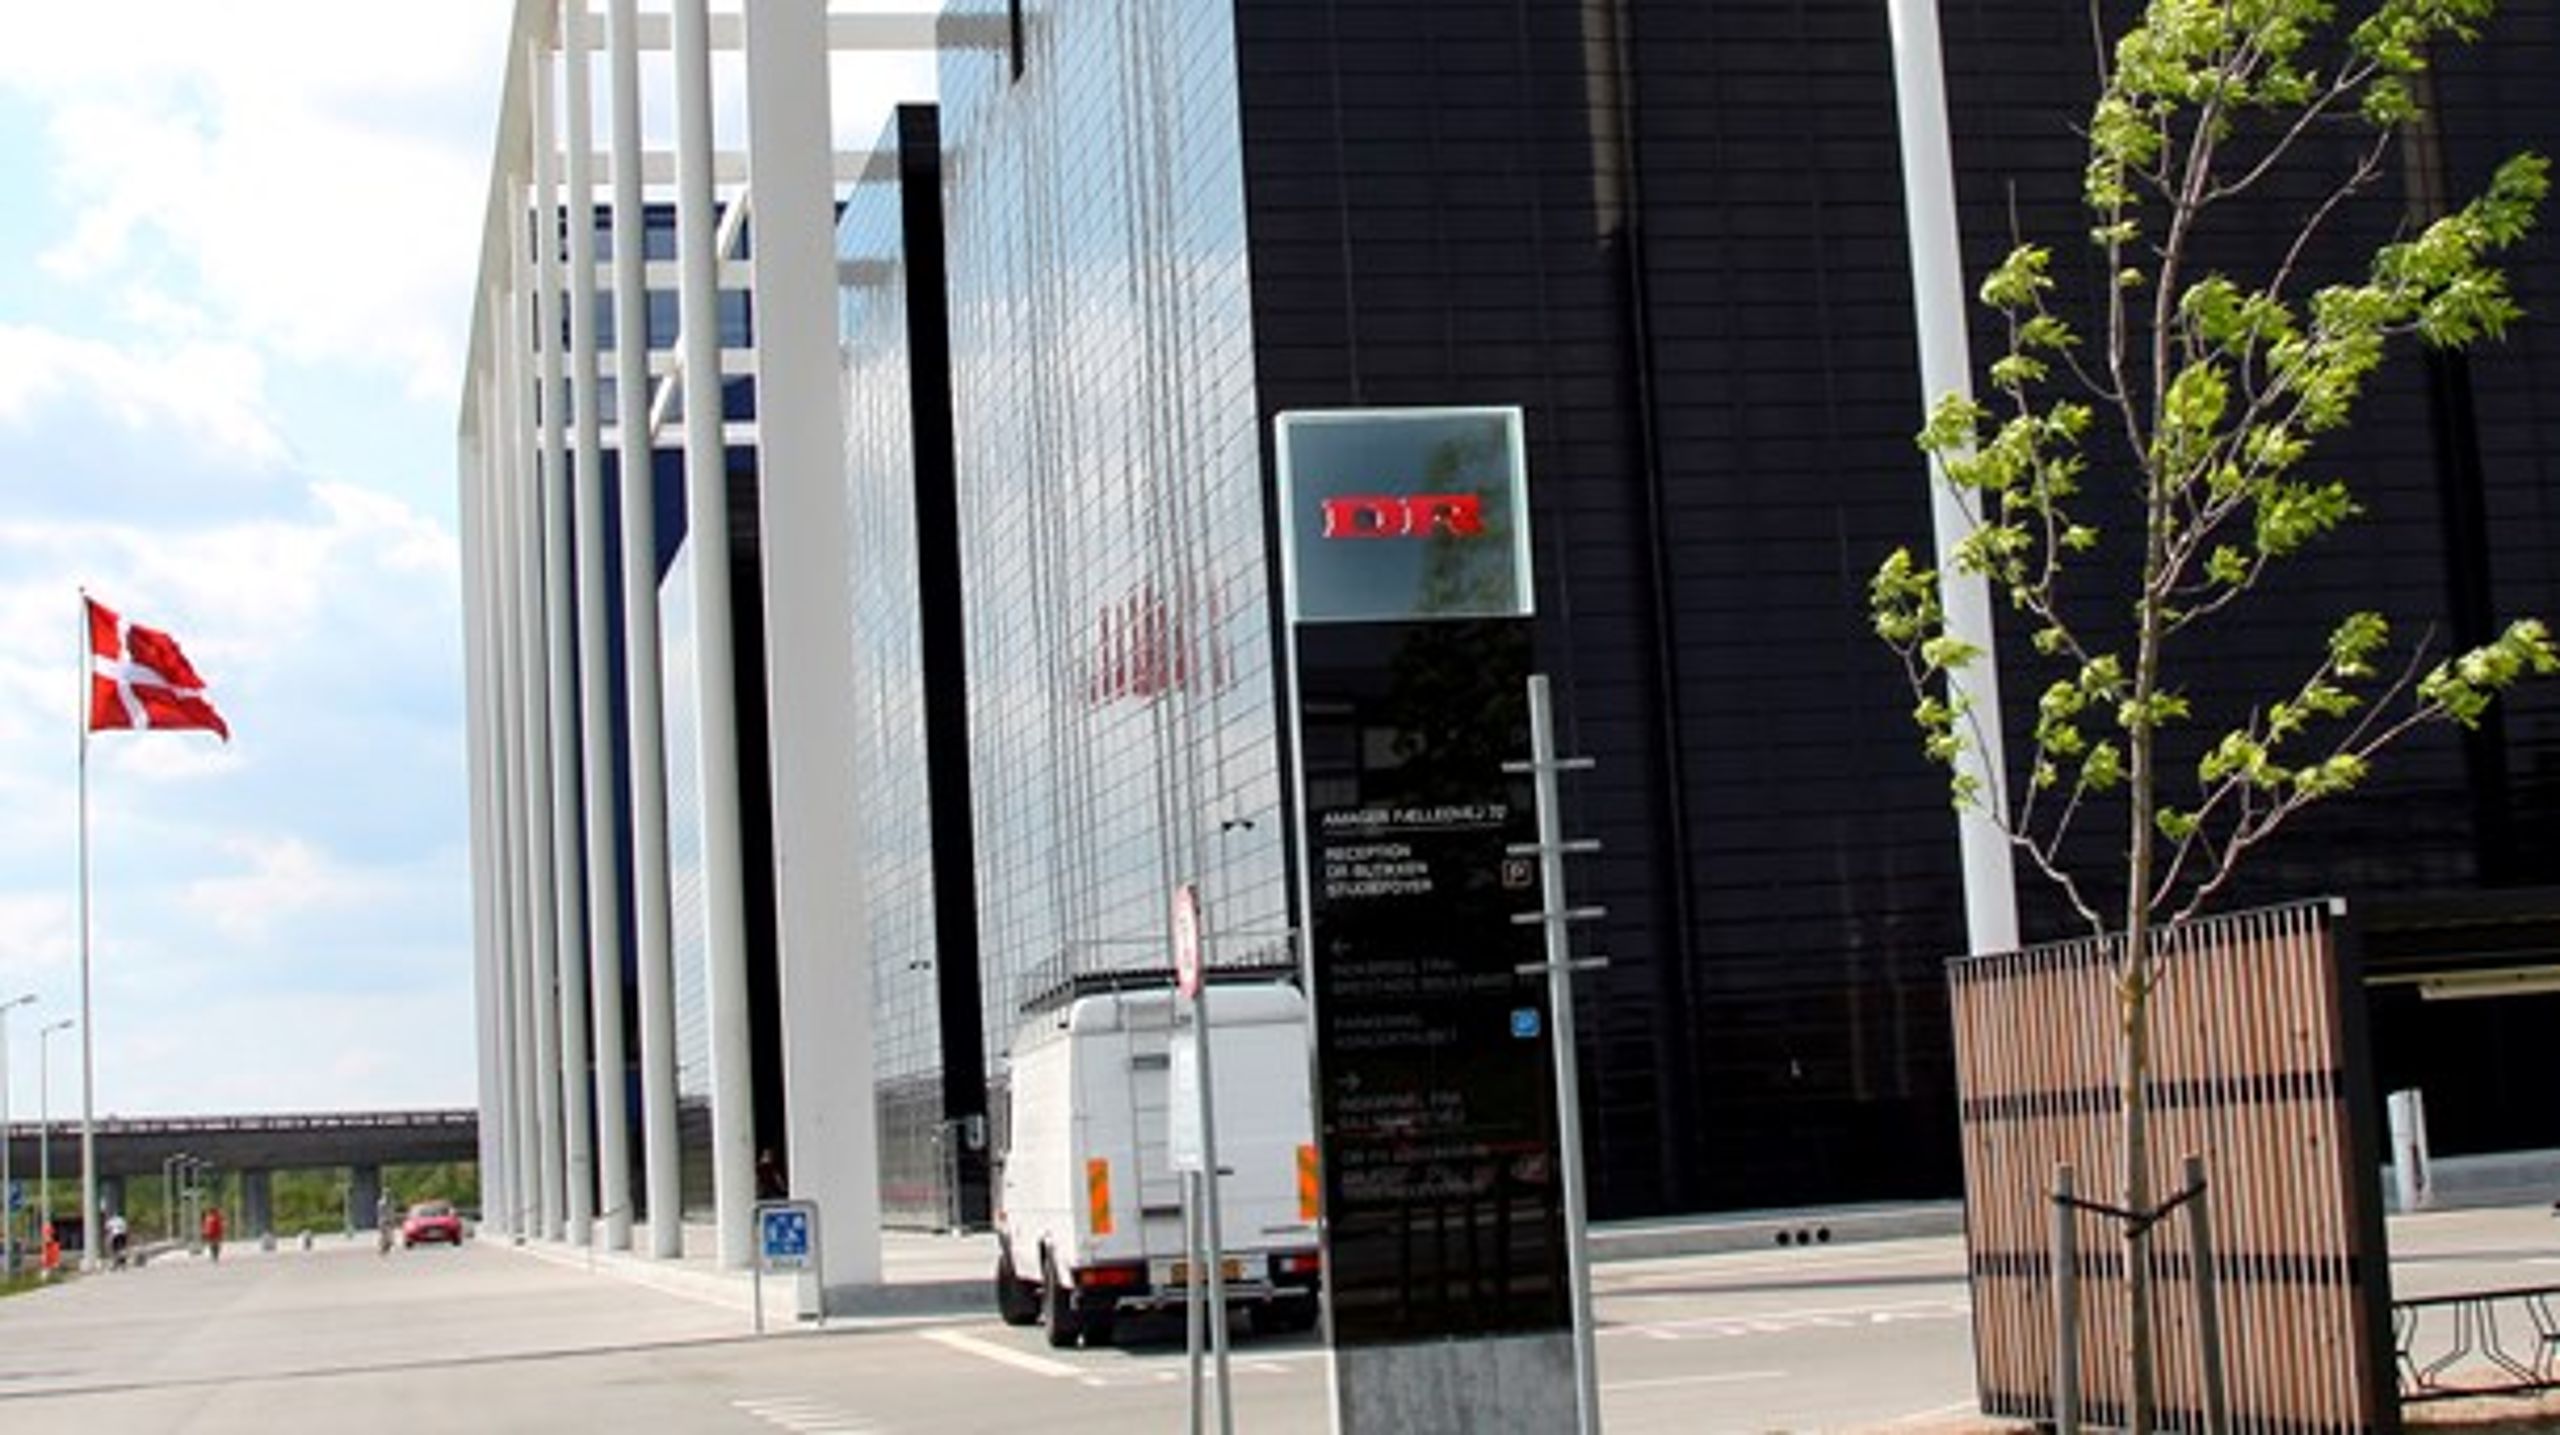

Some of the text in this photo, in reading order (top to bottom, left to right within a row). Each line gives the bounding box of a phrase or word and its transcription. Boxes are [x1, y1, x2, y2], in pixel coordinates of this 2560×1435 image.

[1320, 493, 1486, 538] DR
[1325, 843, 1412, 861] RECEPTION
[1325, 862, 1348, 879] DR
